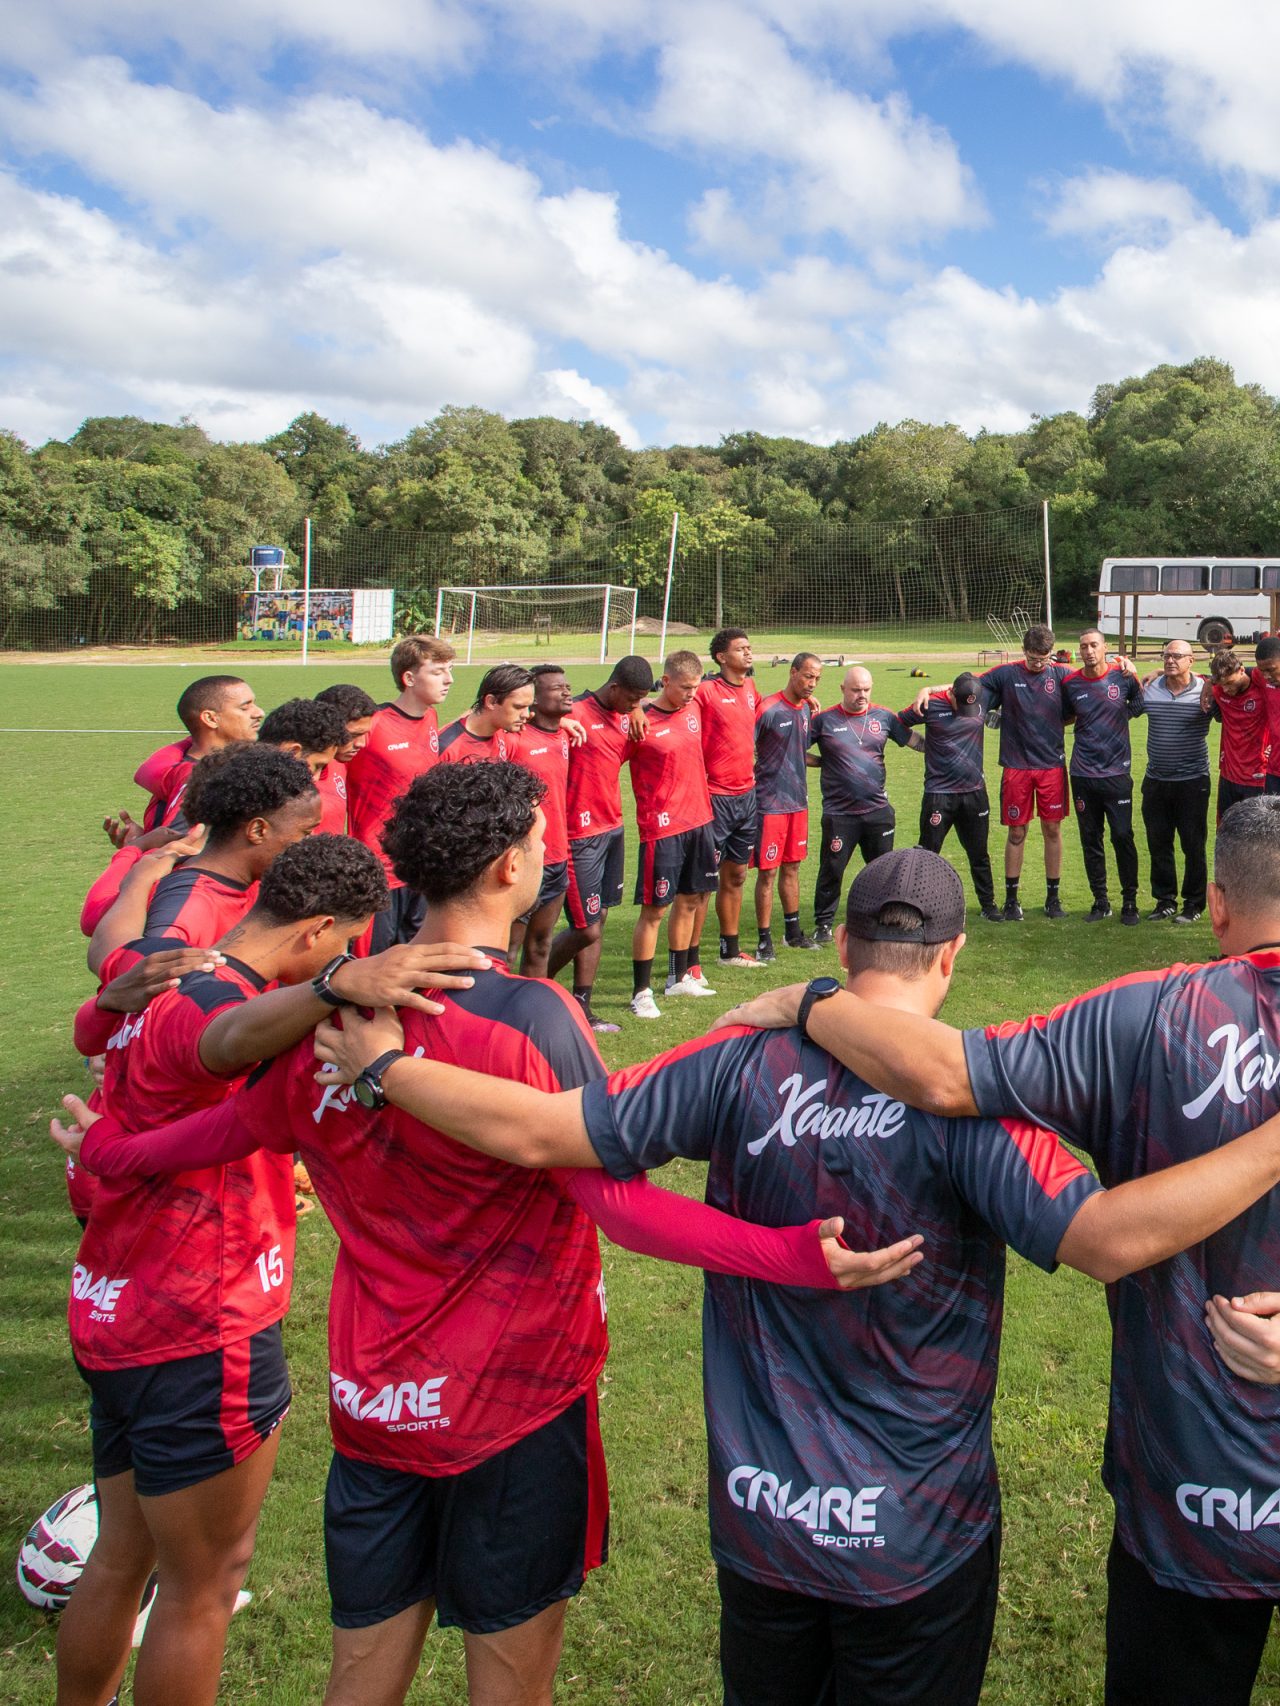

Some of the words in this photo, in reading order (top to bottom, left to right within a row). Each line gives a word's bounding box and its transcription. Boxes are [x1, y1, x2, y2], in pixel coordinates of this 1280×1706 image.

[580, 811, 591, 828] 13
[657, 812, 670, 828] 16
[254, 1243, 284, 1293] 15
[386, 1416, 451, 1433] SPORTS
[727, 1465, 887, 1533] CRIARE
[812, 1533, 886, 1549] SPORTS
